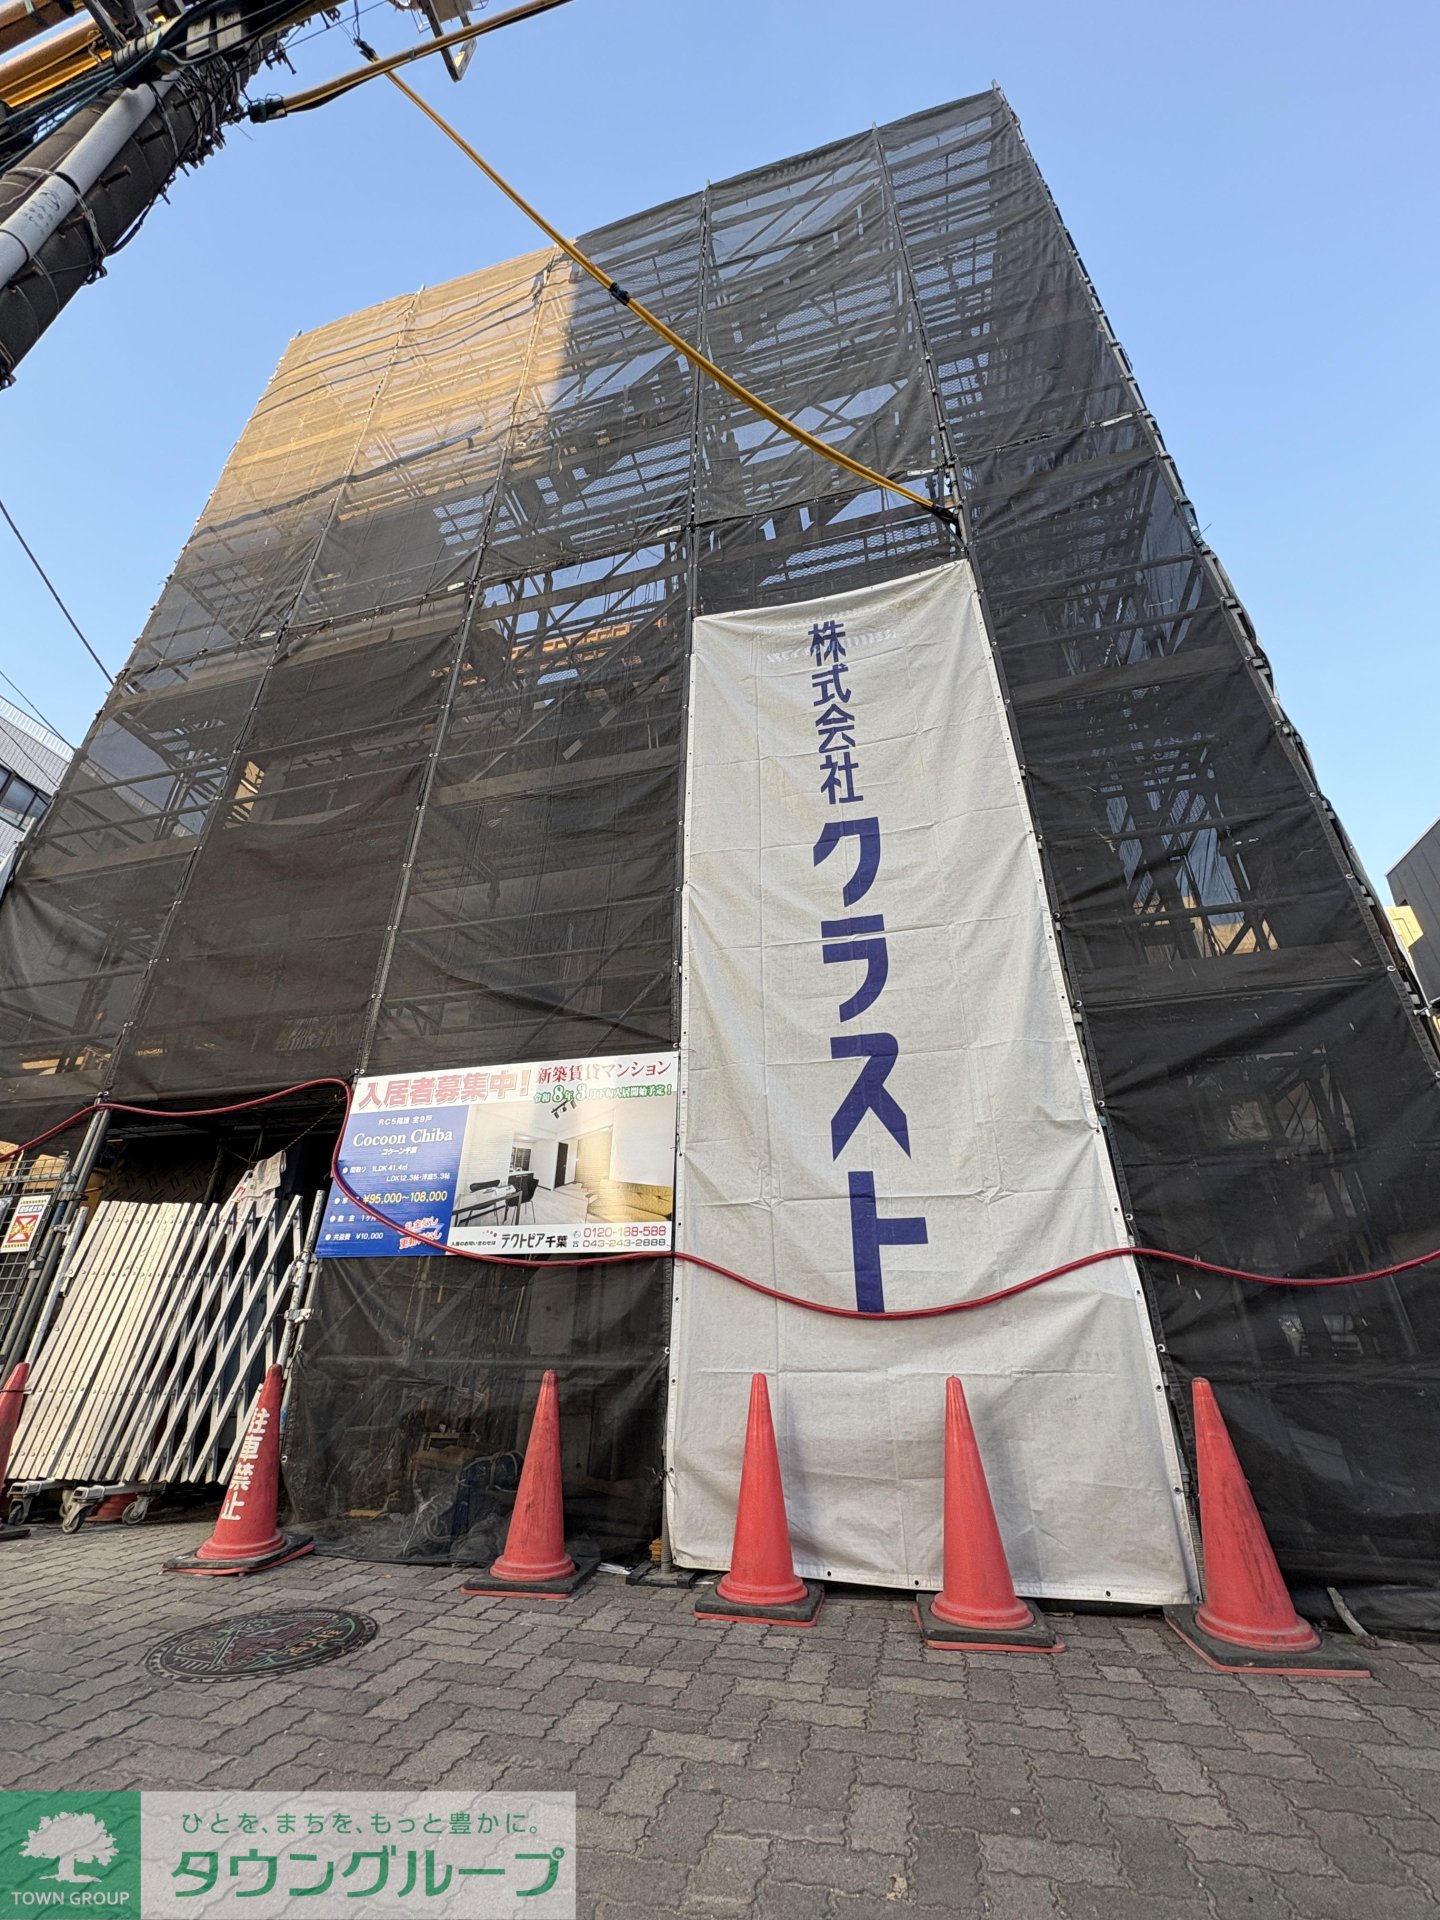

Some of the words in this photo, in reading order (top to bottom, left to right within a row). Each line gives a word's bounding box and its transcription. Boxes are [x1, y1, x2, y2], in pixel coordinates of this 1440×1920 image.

[536, 1060, 672, 1084] 新築賃貸マンション
[352, 1132, 406, 1147] Cocoon
[410, 1127, 453, 1143] Chiba
[355, 1232, 384, 1240] ¥10,000
[501, 1233, 568, 1249] テクトピア千葉
[582, 1238, 666, 1248] 043-243-2888
[220, 1407, 270, 1521] 駐車禁止
